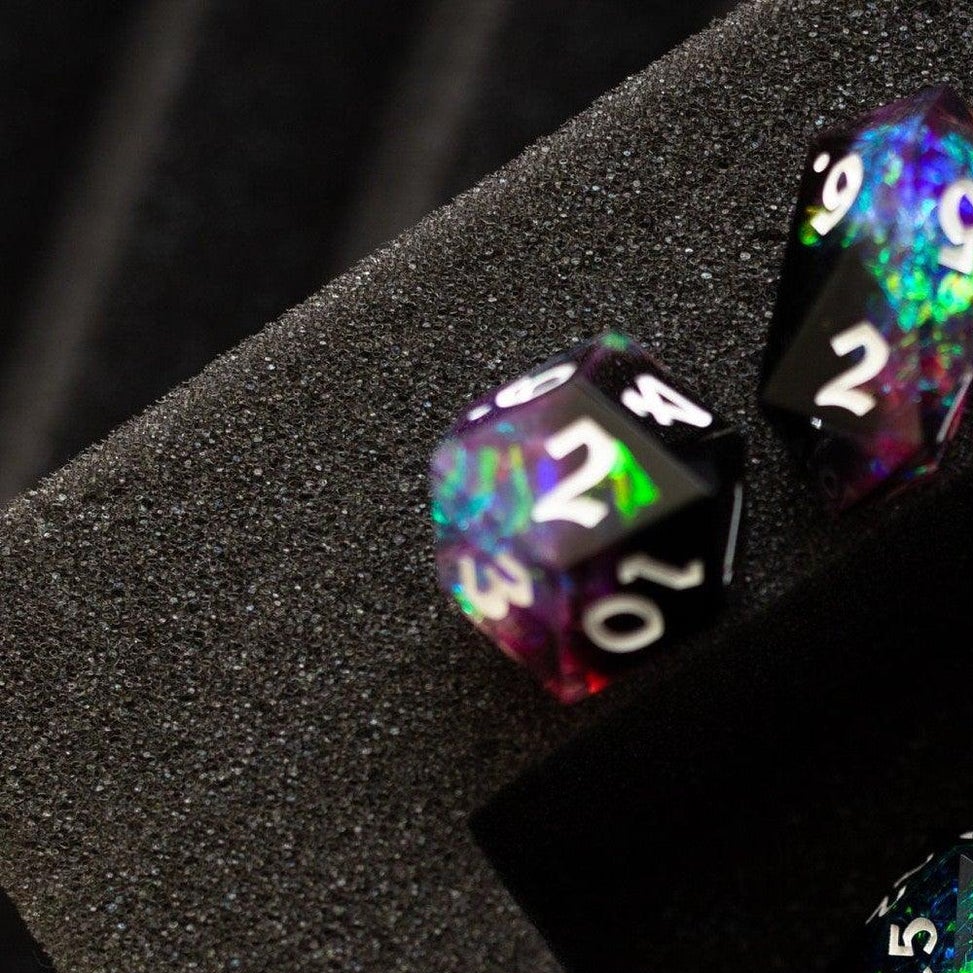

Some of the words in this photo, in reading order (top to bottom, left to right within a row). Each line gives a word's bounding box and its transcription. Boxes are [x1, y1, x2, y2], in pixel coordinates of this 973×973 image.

[621, 373, 713, 428] 4
[814, 321, 891, 417] 2
[530, 417, 618, 529] 2
